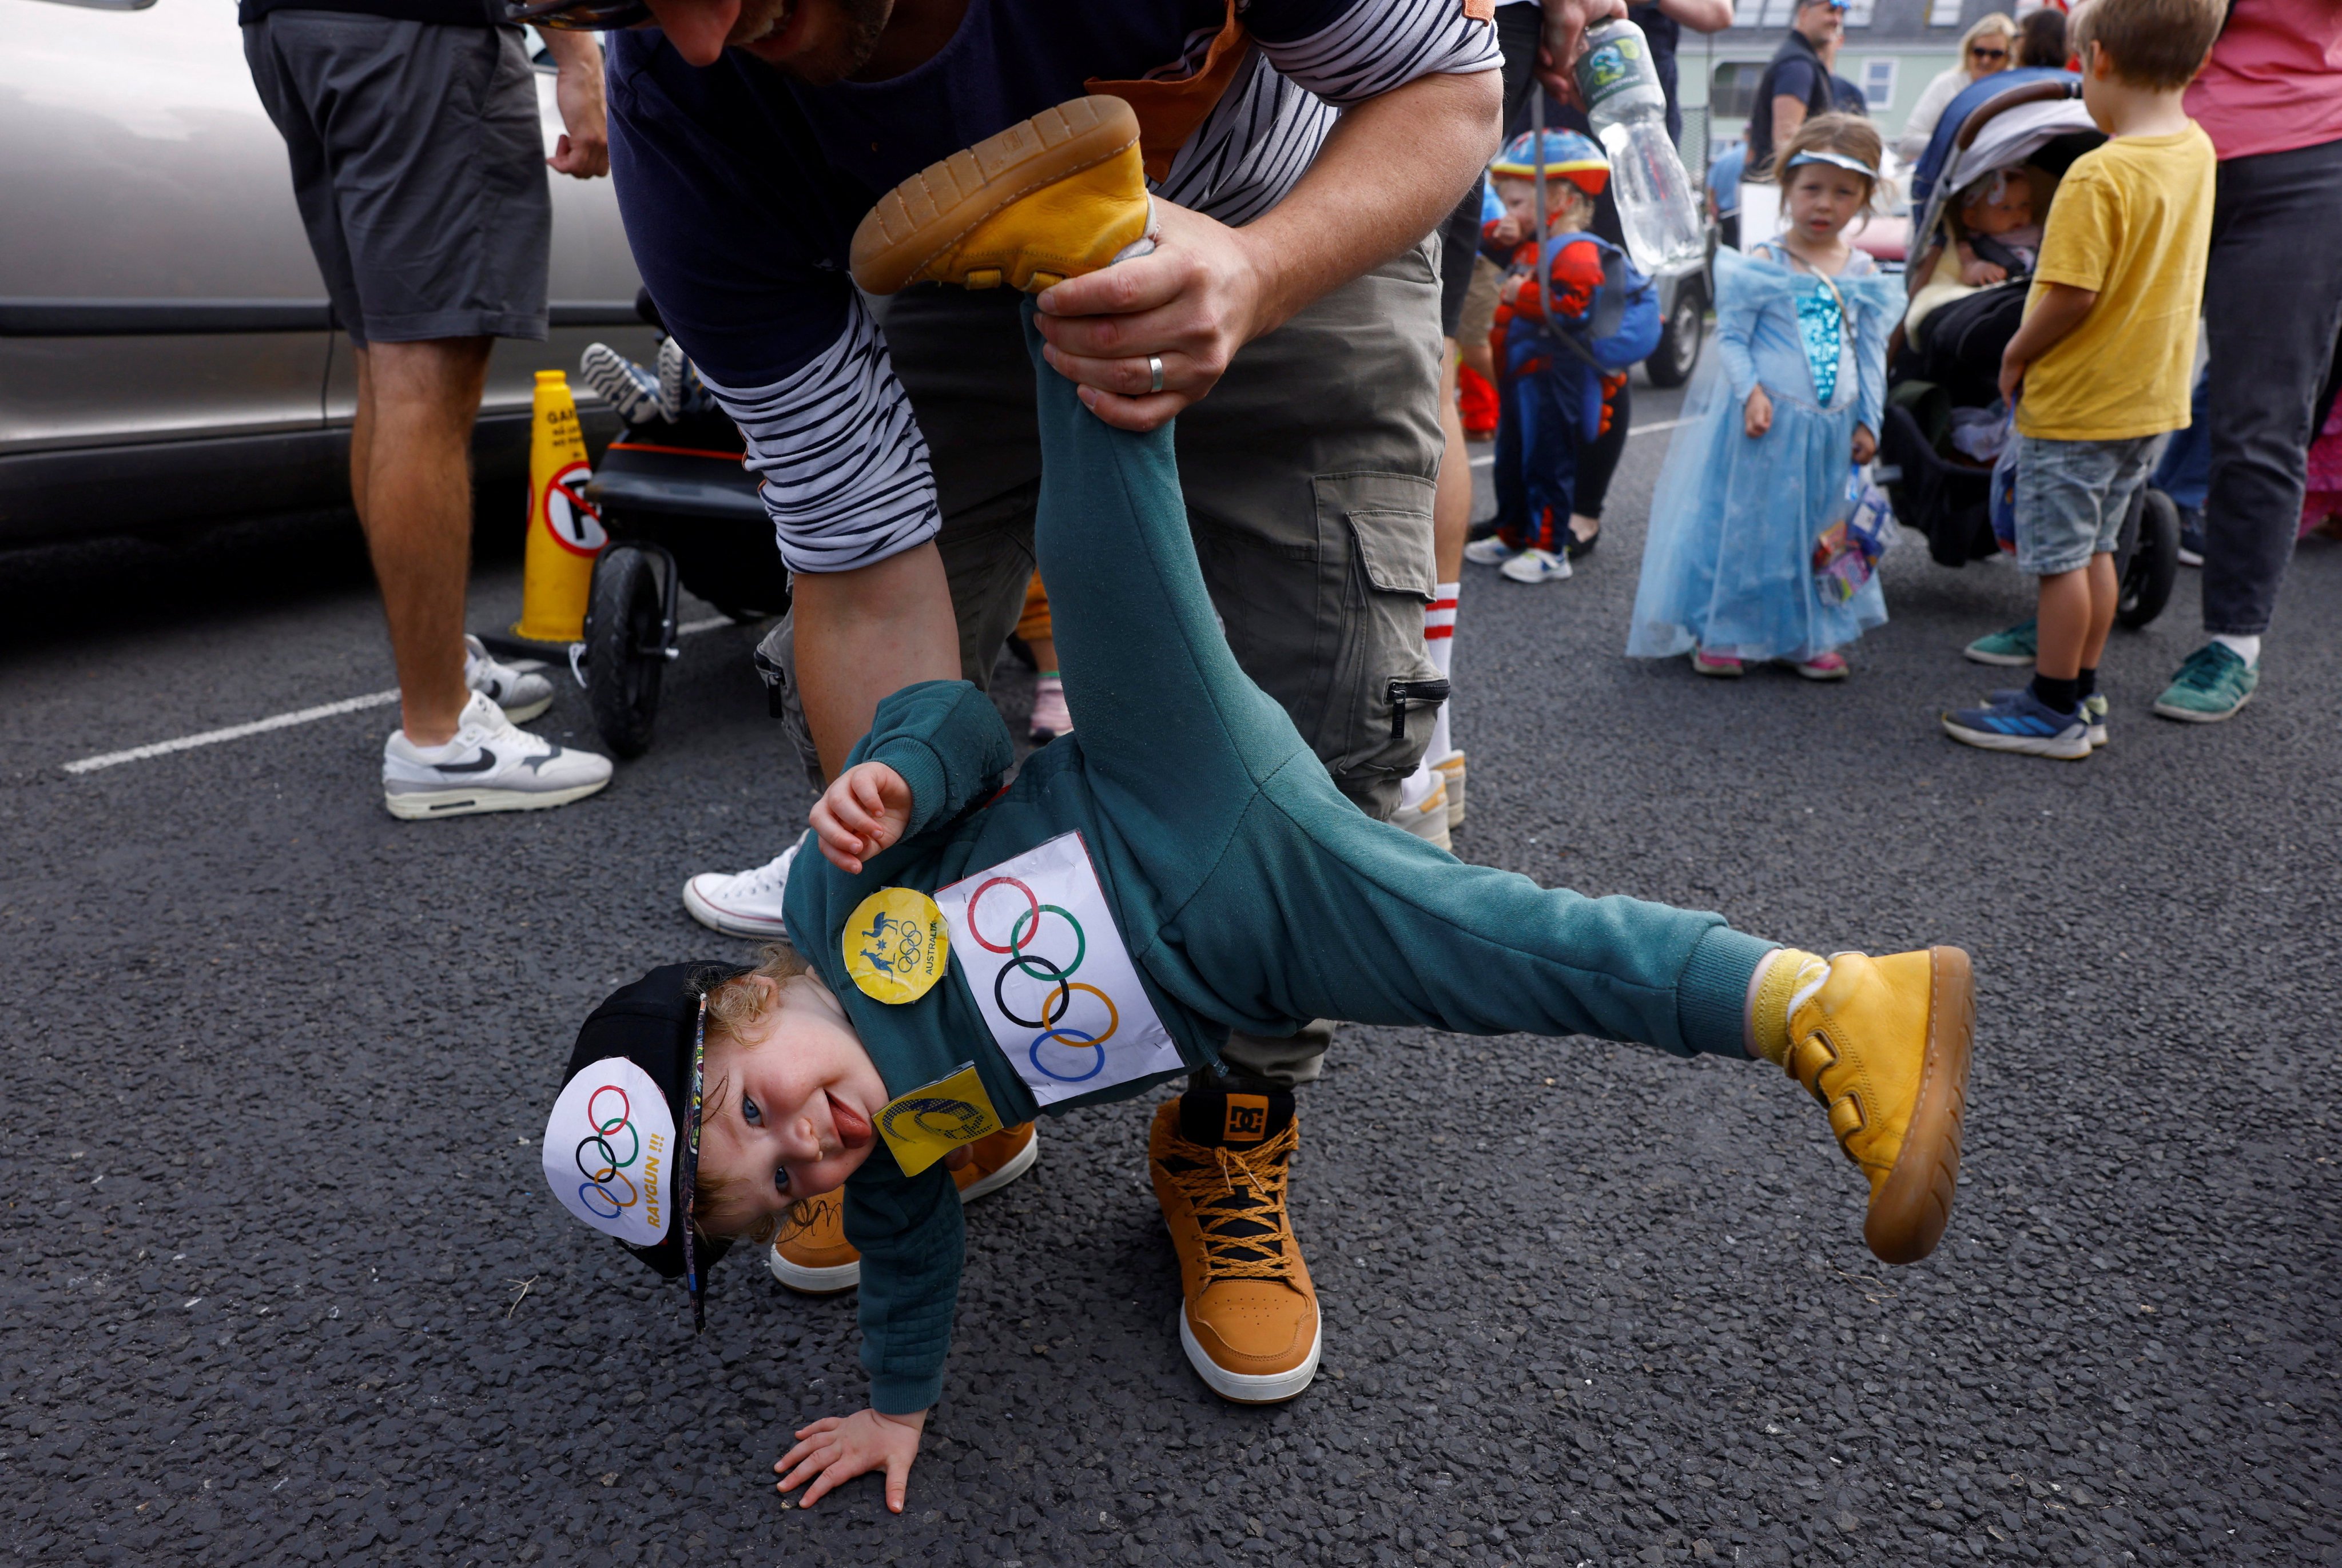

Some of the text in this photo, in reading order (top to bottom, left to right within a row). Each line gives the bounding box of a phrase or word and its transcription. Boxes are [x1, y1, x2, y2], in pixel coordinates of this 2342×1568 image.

[925, 921, 937, 976] AUSTRALIA
[1230, 1106, 1264, 1133] DC
[644, 1133, 665, 1228] RAYGUN !!!
